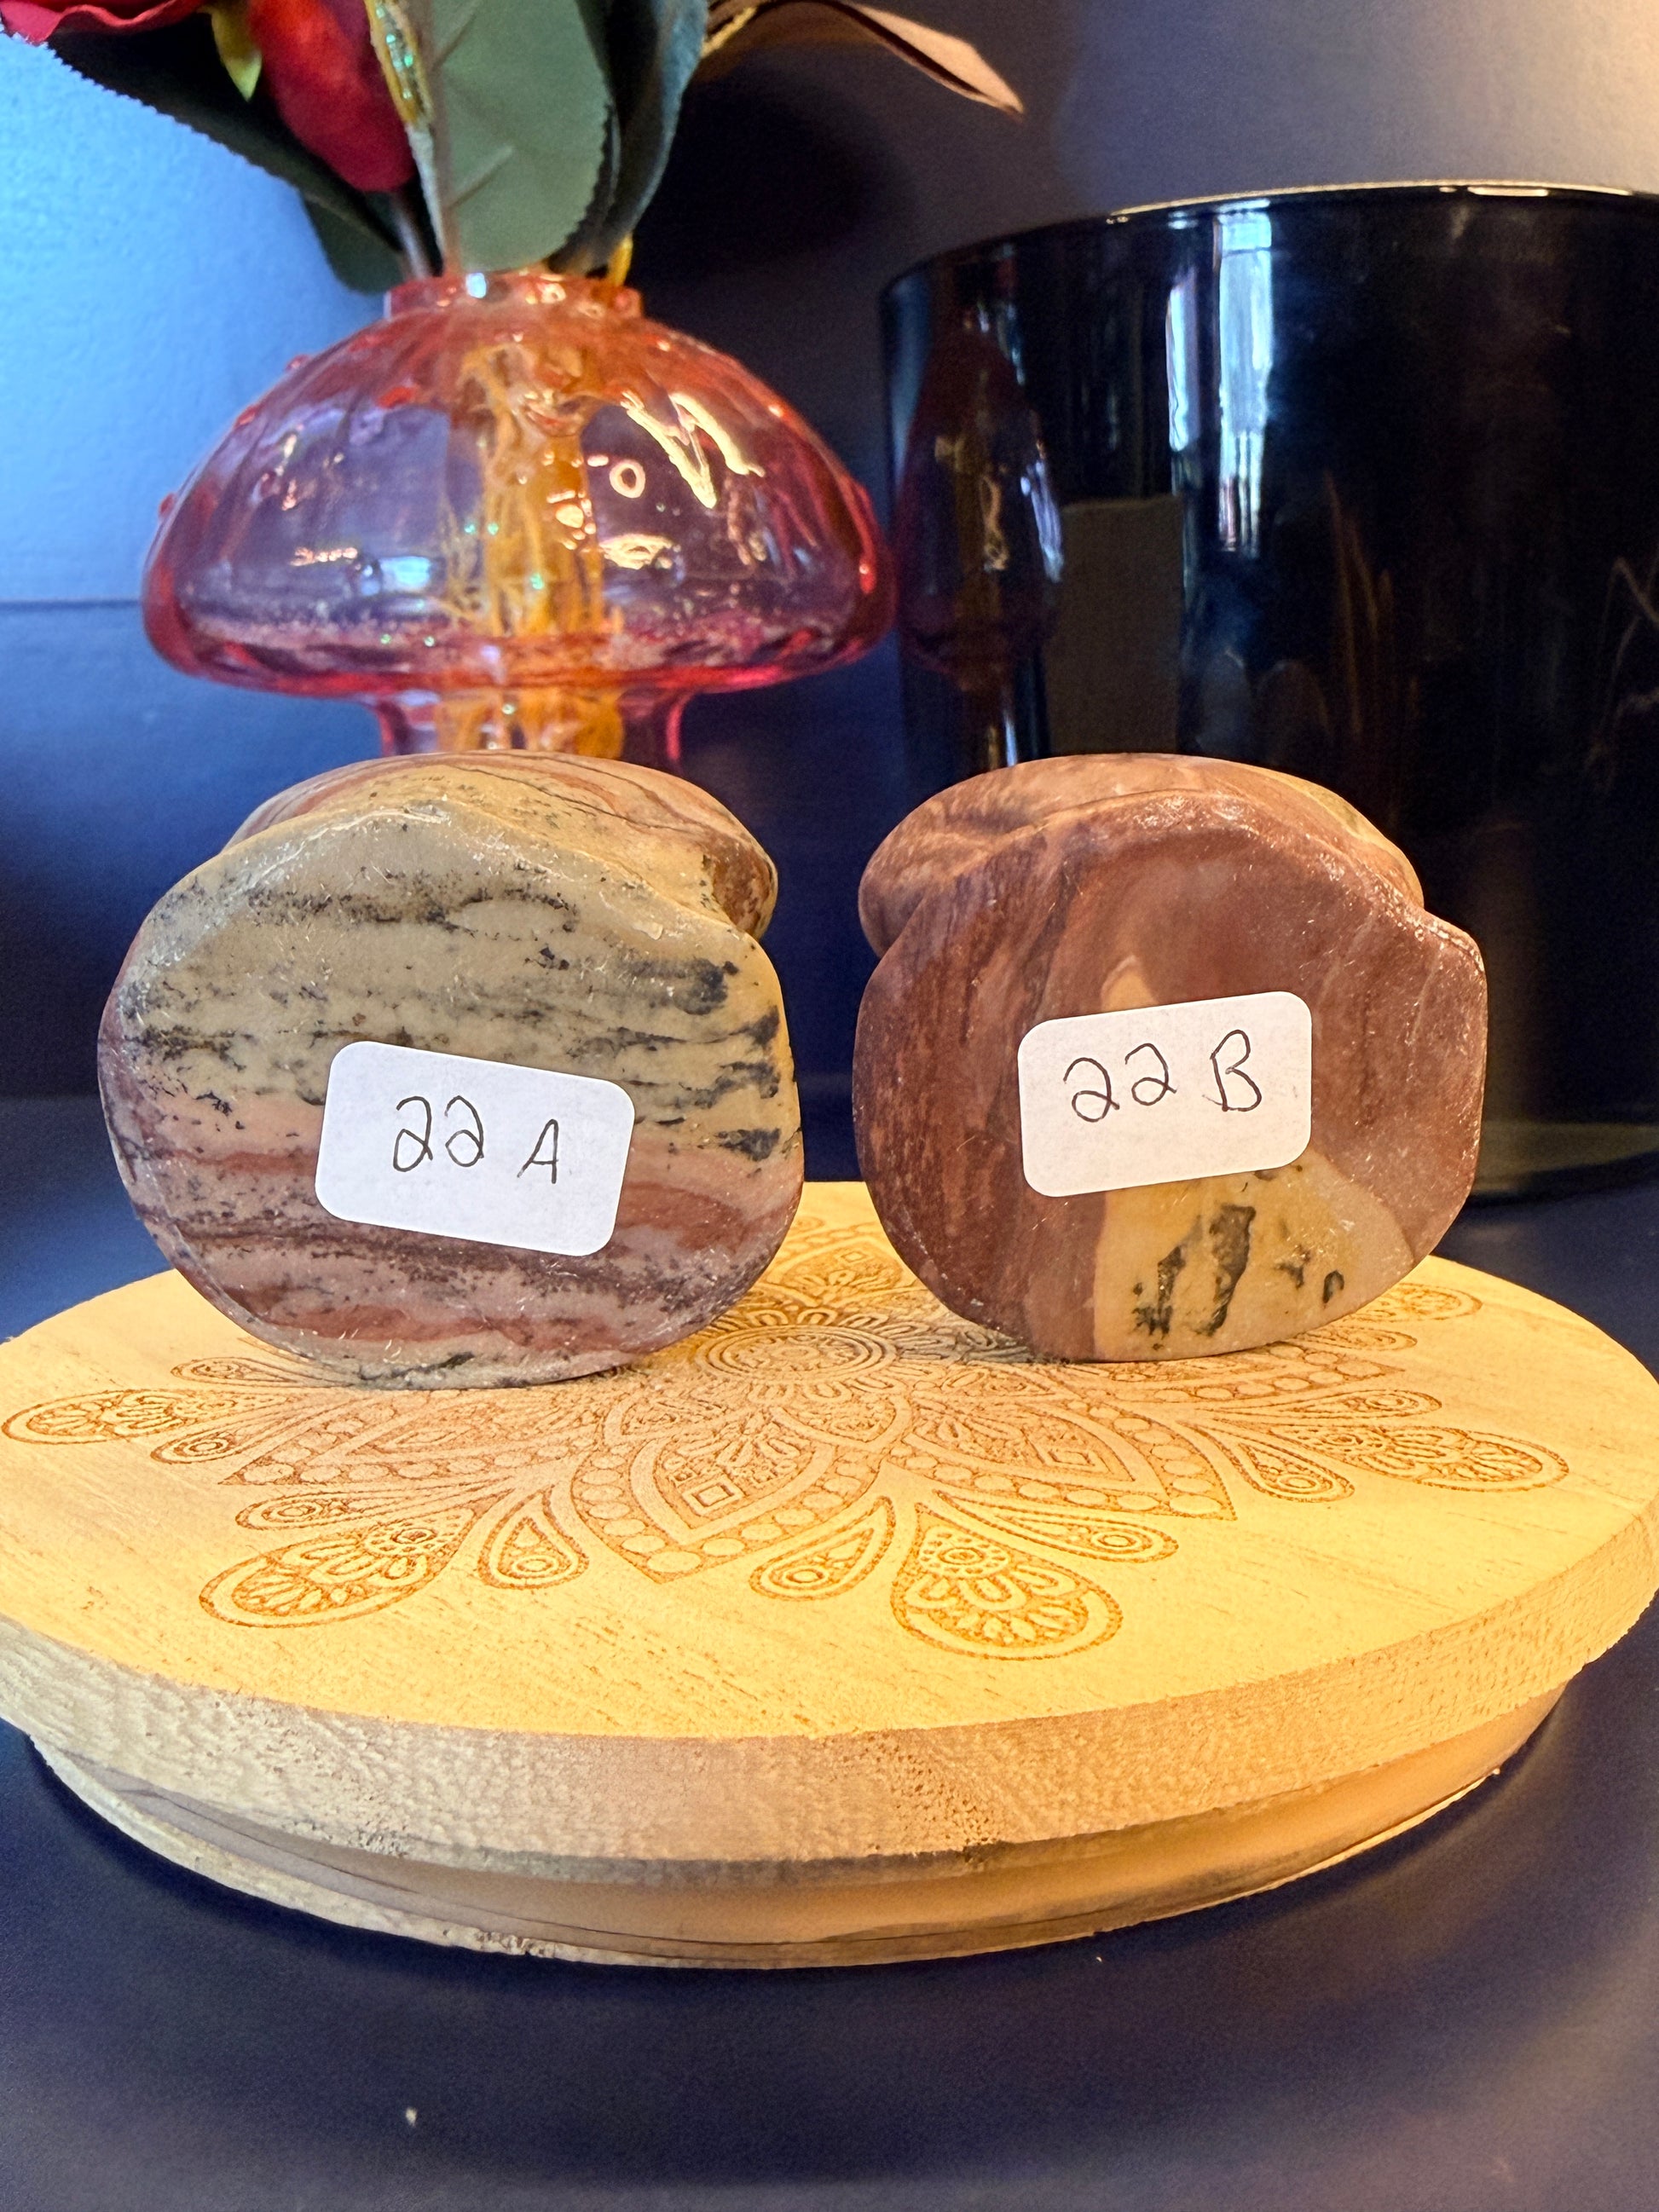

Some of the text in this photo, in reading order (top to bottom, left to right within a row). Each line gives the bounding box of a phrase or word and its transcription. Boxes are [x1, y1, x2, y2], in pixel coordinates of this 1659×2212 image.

[1062, 1029, 1263, 1123] 22 B
[392, 1095, 559, 1185] 22 A
